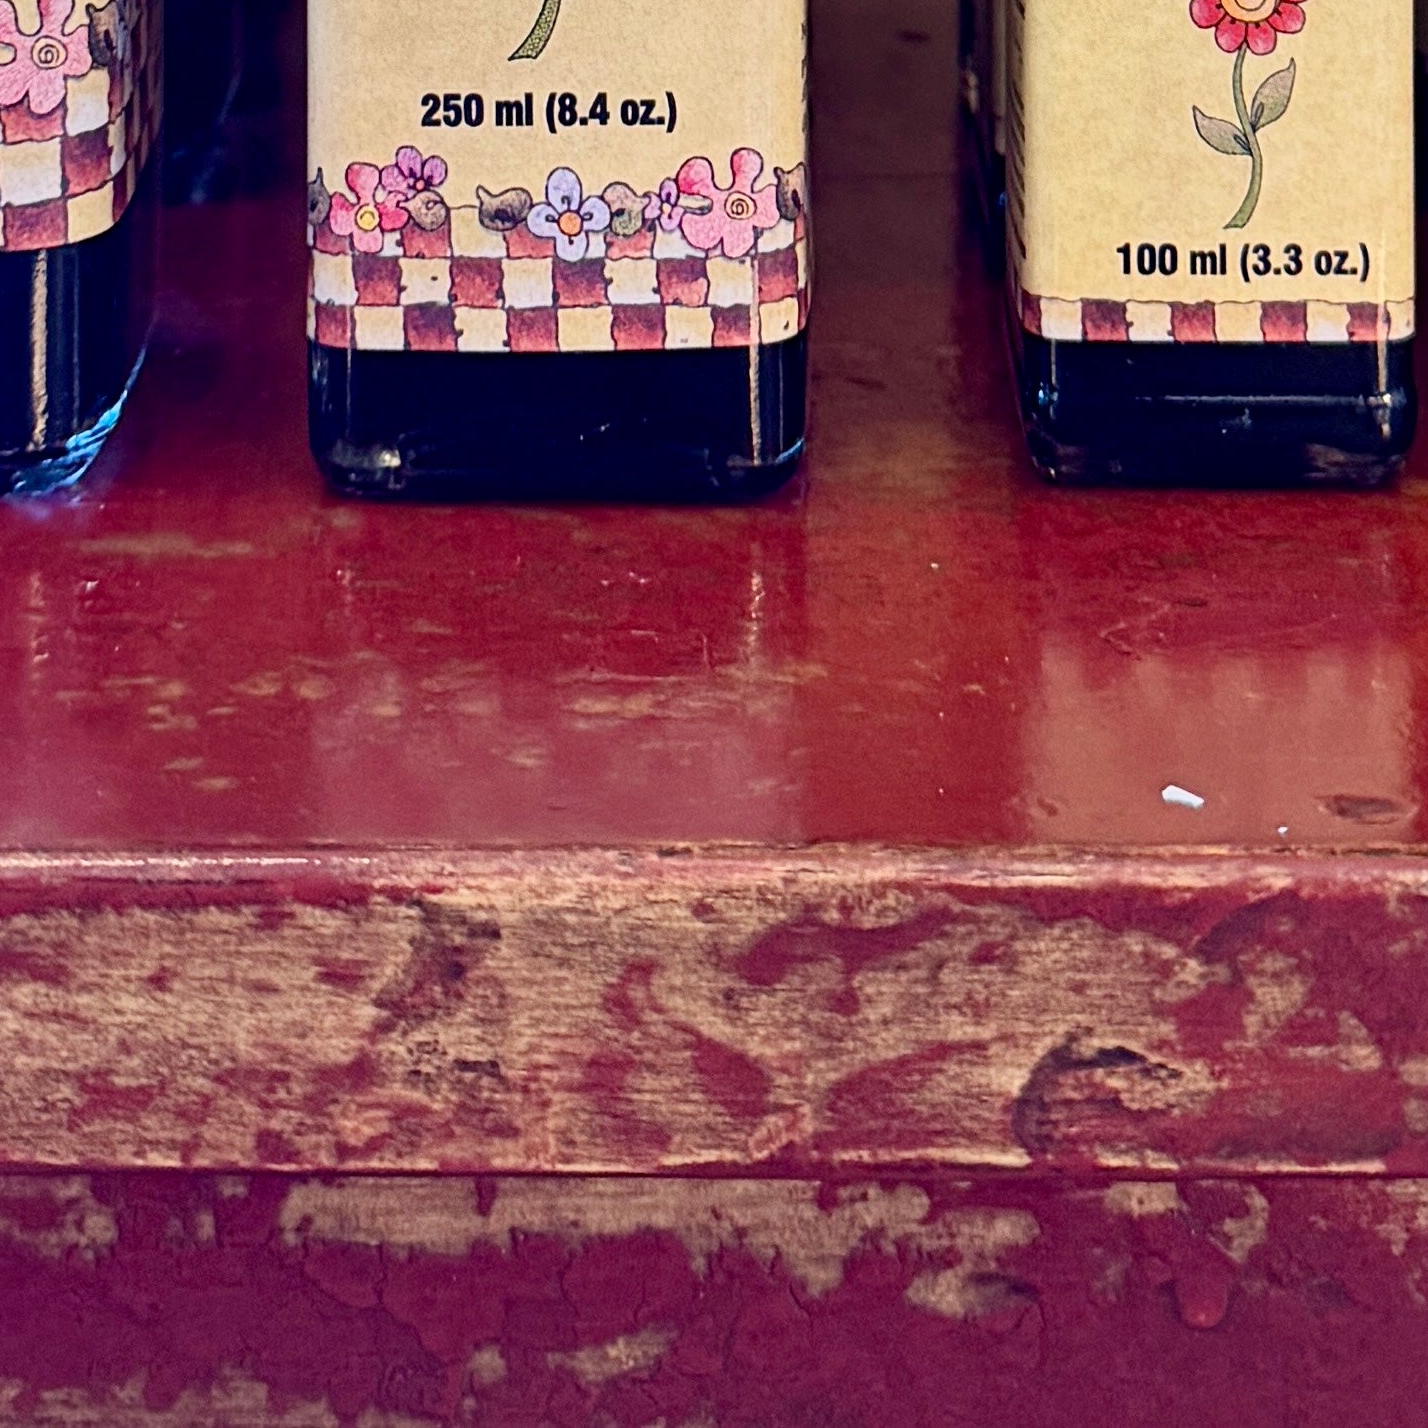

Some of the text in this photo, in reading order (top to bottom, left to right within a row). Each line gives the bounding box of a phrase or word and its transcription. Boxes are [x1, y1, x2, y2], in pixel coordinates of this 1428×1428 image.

[420, 90, 677, 134] 250 ml (8.4 oz.)
[1115, 242, 1370, 284] 100 ml (3.3 oz.)
